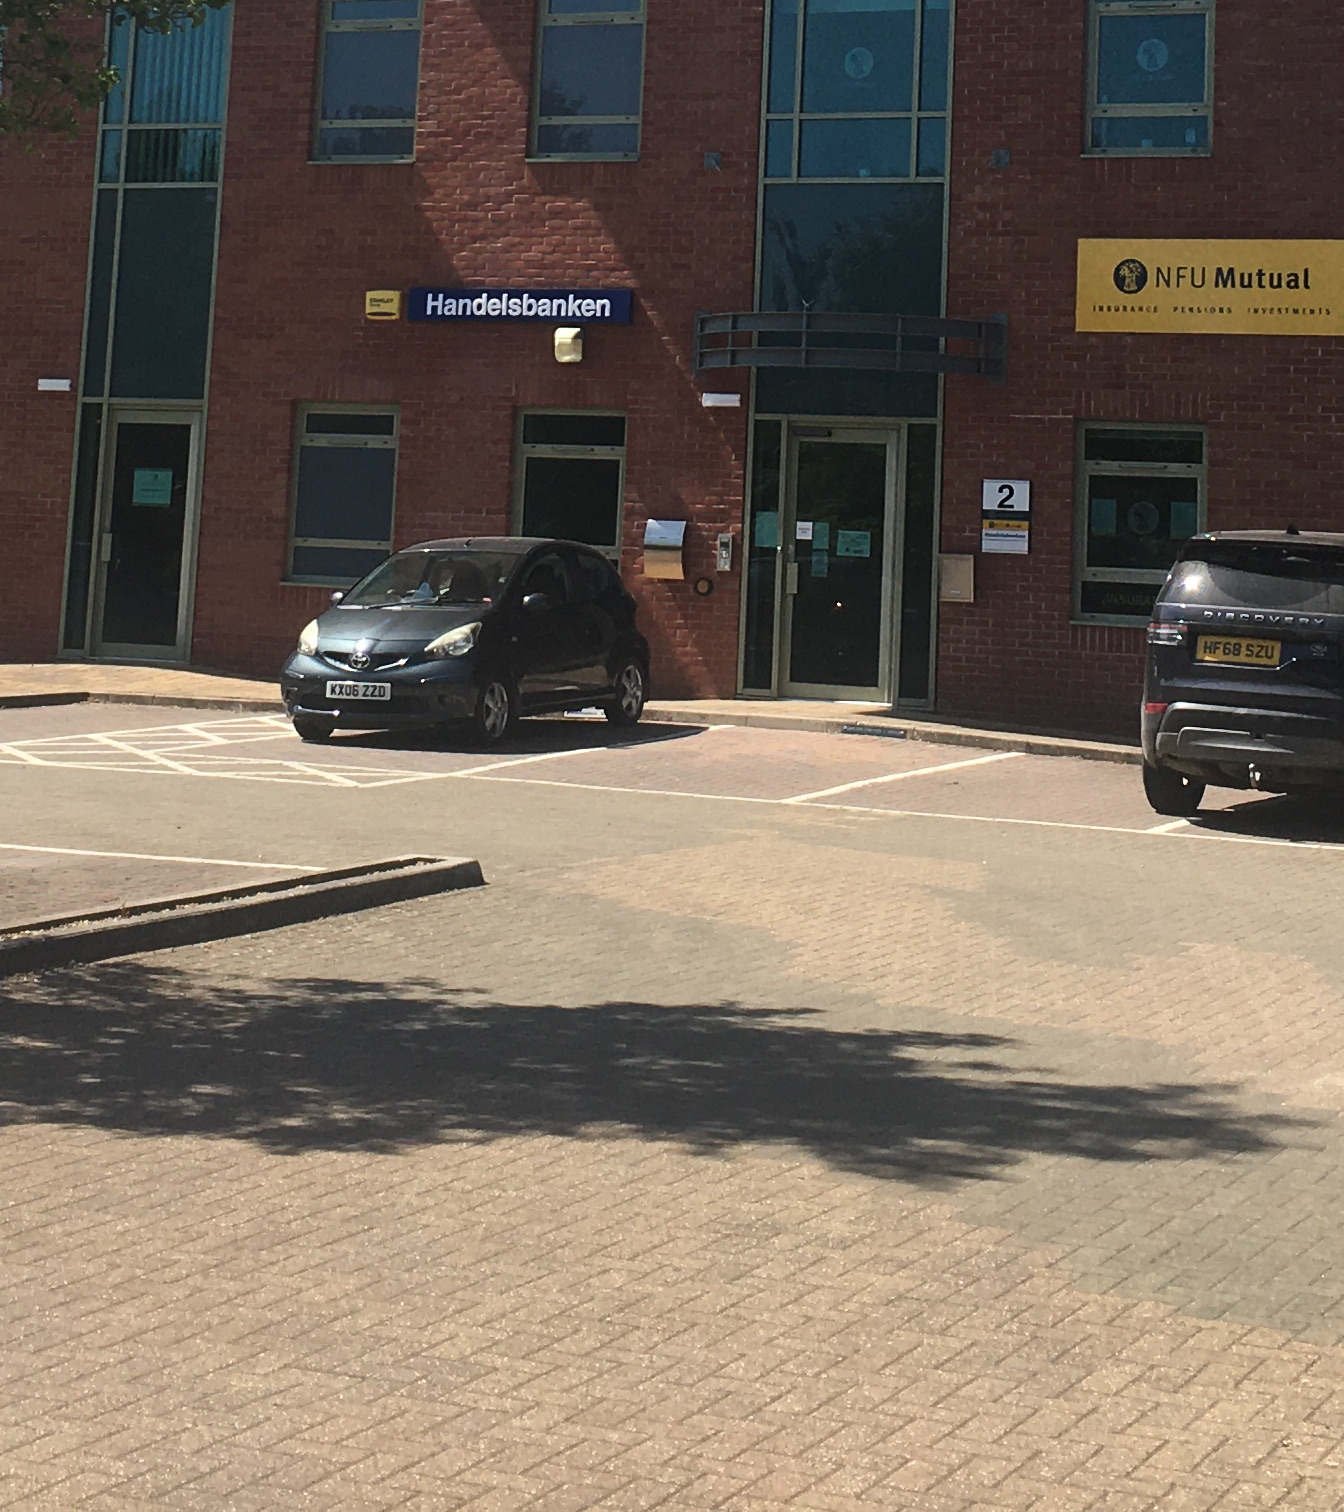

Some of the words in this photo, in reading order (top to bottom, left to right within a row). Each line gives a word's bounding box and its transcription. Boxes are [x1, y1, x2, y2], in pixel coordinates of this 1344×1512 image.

[1155, 266, 1206, 289] NFU
[1214, 267, 1311, 290] Mutual
[426, 293, 611, 317] Handelsbanken
[1092, 304, 1159, 314] INSURANCE
[1172, 305, 1233, 315] PENSIONS
[1246, 306, 1332, 317] INVESTMENTS
[997, 484, 1015, 509] 2
[1203, 610, 1324, 624] DISCOVERY
[1203, 640, 1241, 657] HF68
[1245, 643, 1275, 660] SZU
[330, 683, 359, 697] KX06
[362, 685, 386, 698] ZZD
